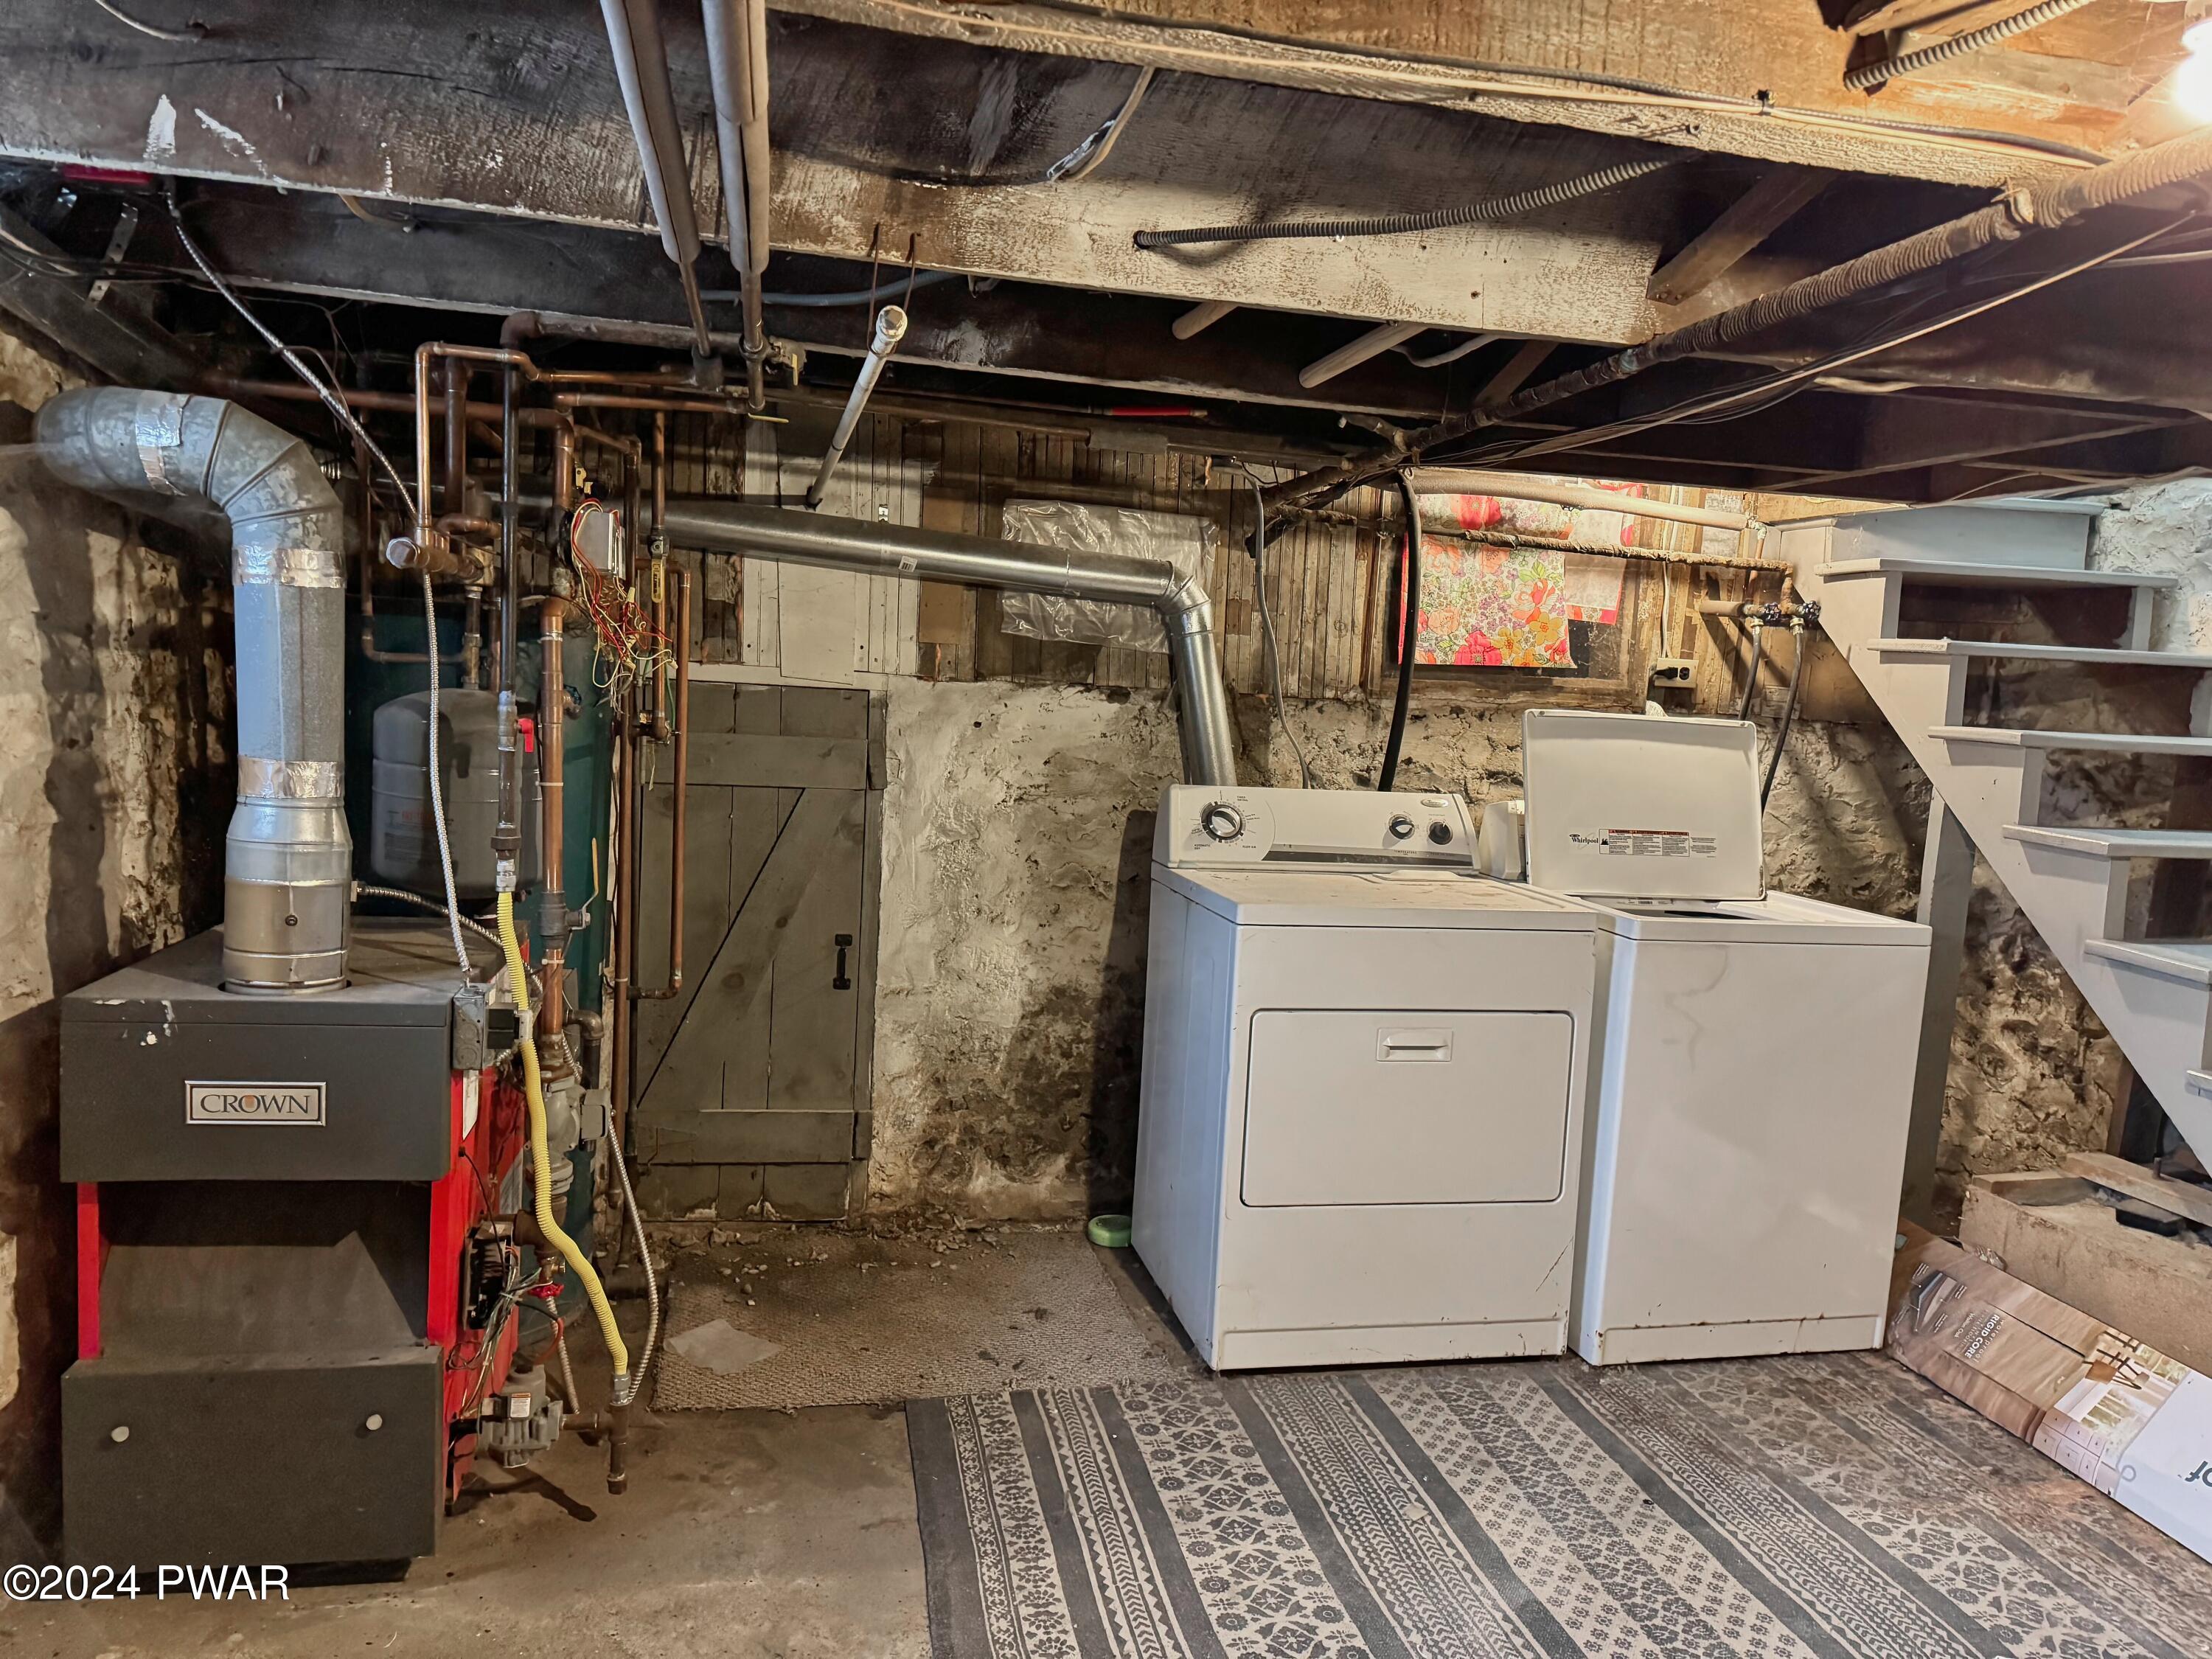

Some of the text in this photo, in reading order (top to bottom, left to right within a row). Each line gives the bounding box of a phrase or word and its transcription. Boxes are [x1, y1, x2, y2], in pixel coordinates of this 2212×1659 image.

[200, 1093, 312, 1114] CROWN
[1964, 1313, 2000, 1358] RIGID CORE
